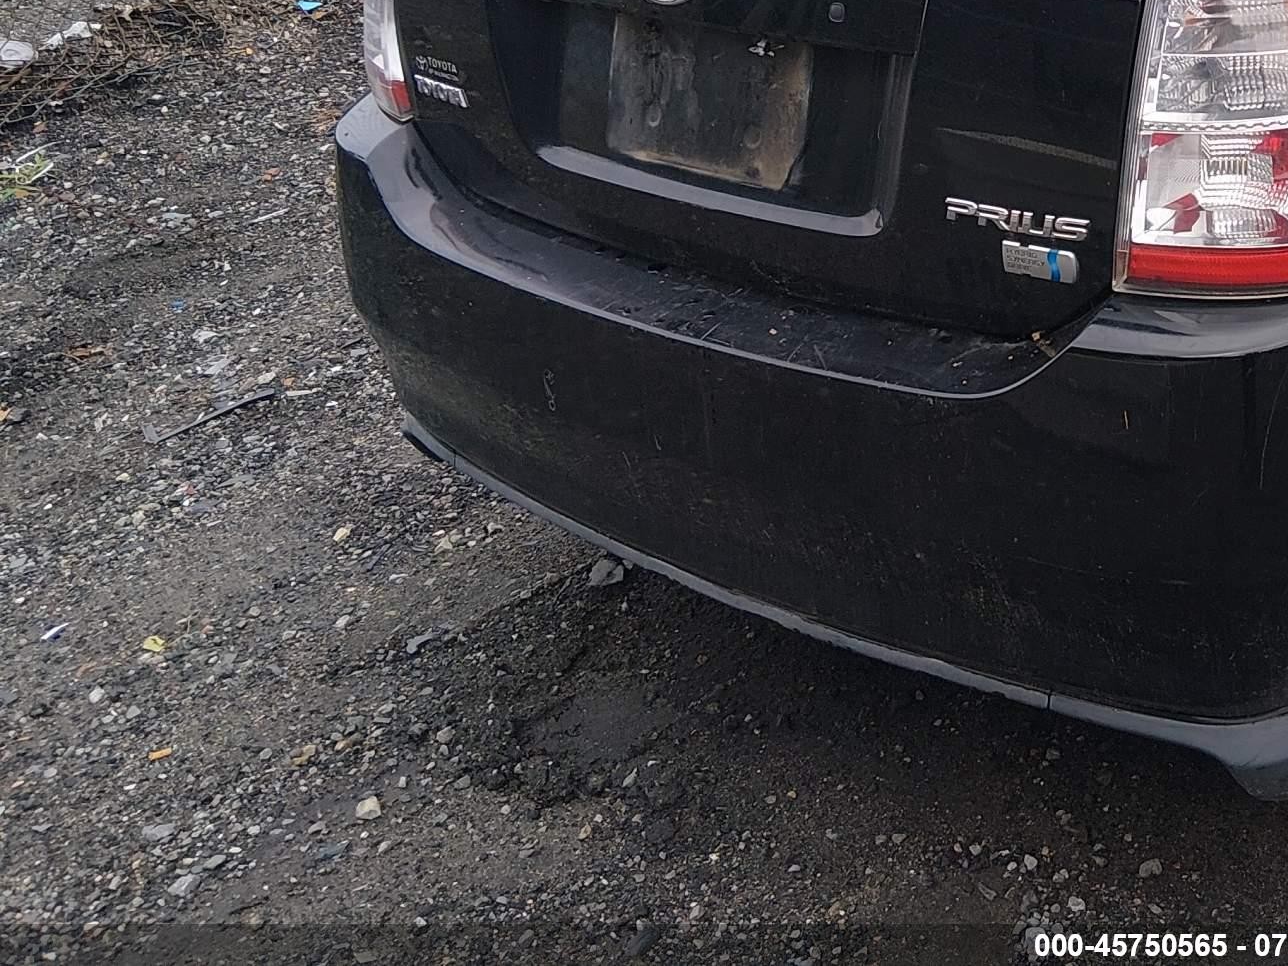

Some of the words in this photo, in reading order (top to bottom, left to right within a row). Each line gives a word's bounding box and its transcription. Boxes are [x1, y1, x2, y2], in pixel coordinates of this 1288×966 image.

[427, 56, 459, 74] TOYOTA
[414, 74, 469, 109] TOYOTA
[945, 197, 1091, 242] PRIUS
